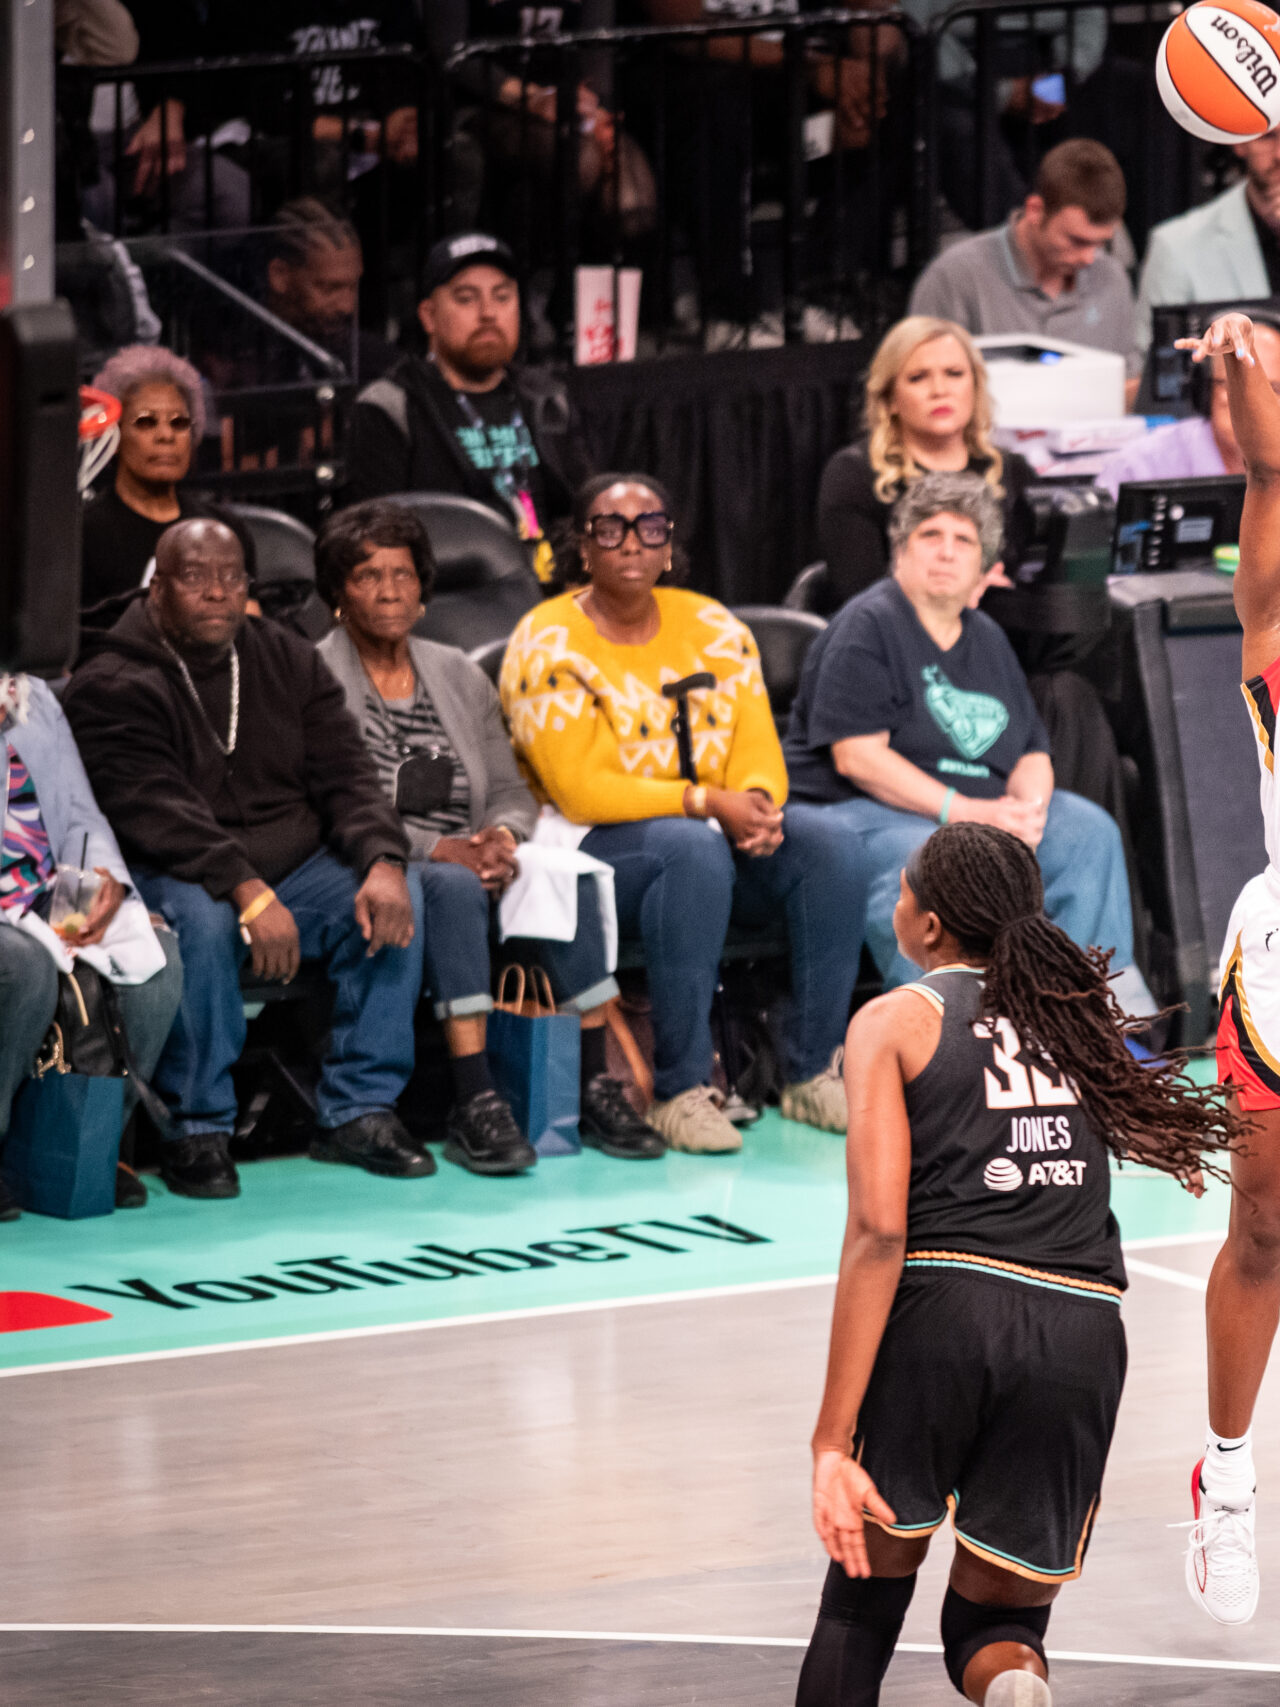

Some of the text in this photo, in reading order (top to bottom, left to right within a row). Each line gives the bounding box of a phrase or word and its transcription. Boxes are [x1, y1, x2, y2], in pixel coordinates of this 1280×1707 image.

[1210, 15, 1278, 98] Wilson
[1005, 1114, 1073, 1153] JONES
[1027, 1159, 1088, 1187] AT&T
